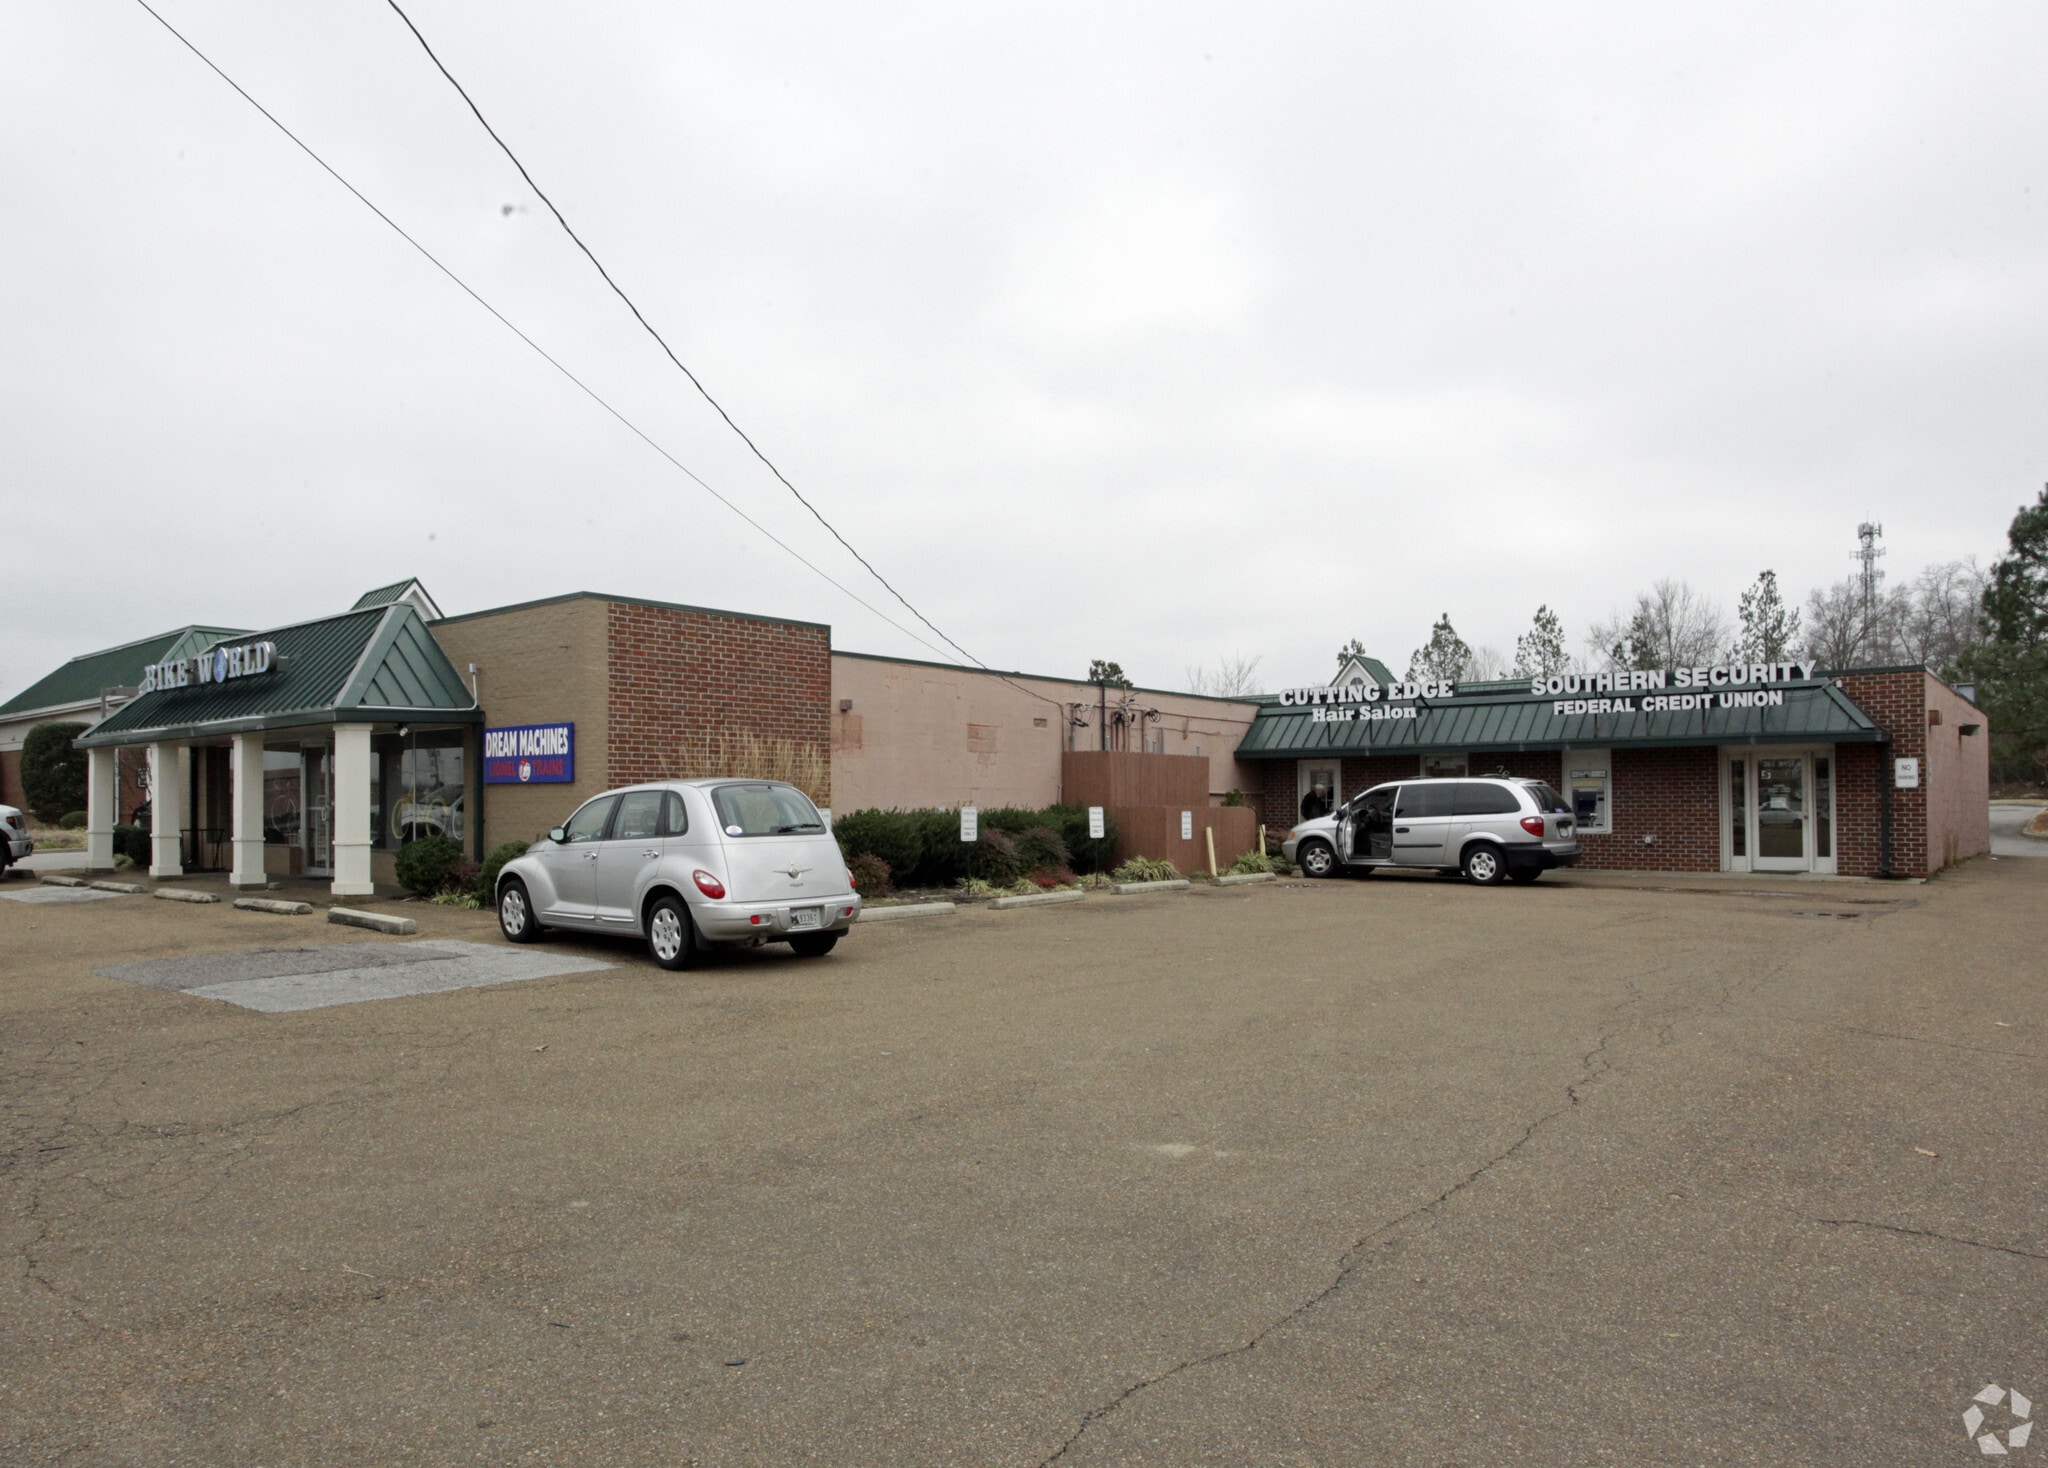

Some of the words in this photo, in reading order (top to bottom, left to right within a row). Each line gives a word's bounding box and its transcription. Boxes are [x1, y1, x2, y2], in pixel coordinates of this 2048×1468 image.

[144, 659, 188, 692] BIKE
[197, 641, 272, 683] WORLD
[1531, 670, 1666, 696] SOUTHERN
[1674, 660, 1816, 687] SECURITY
[1279, 684, 1381, 706] CUTTING
[1387, 680, 1453, 700] EDGE
[1553, 698, 1636, 715] FEDERAL
[1642, 694, 1714, 711] CREDIT
[1720, 690, 1783, 708] UNION
[1312, 707, 1356, 722] Hair
[1359, 705, 1417, 721] Salon
[485, 731, 517, 758] DREAM
[519, 727, 569, 756] MACHINES
[489, 761, 517, 777] LIONEL
[532, 759, 564, 776] TRAINS
